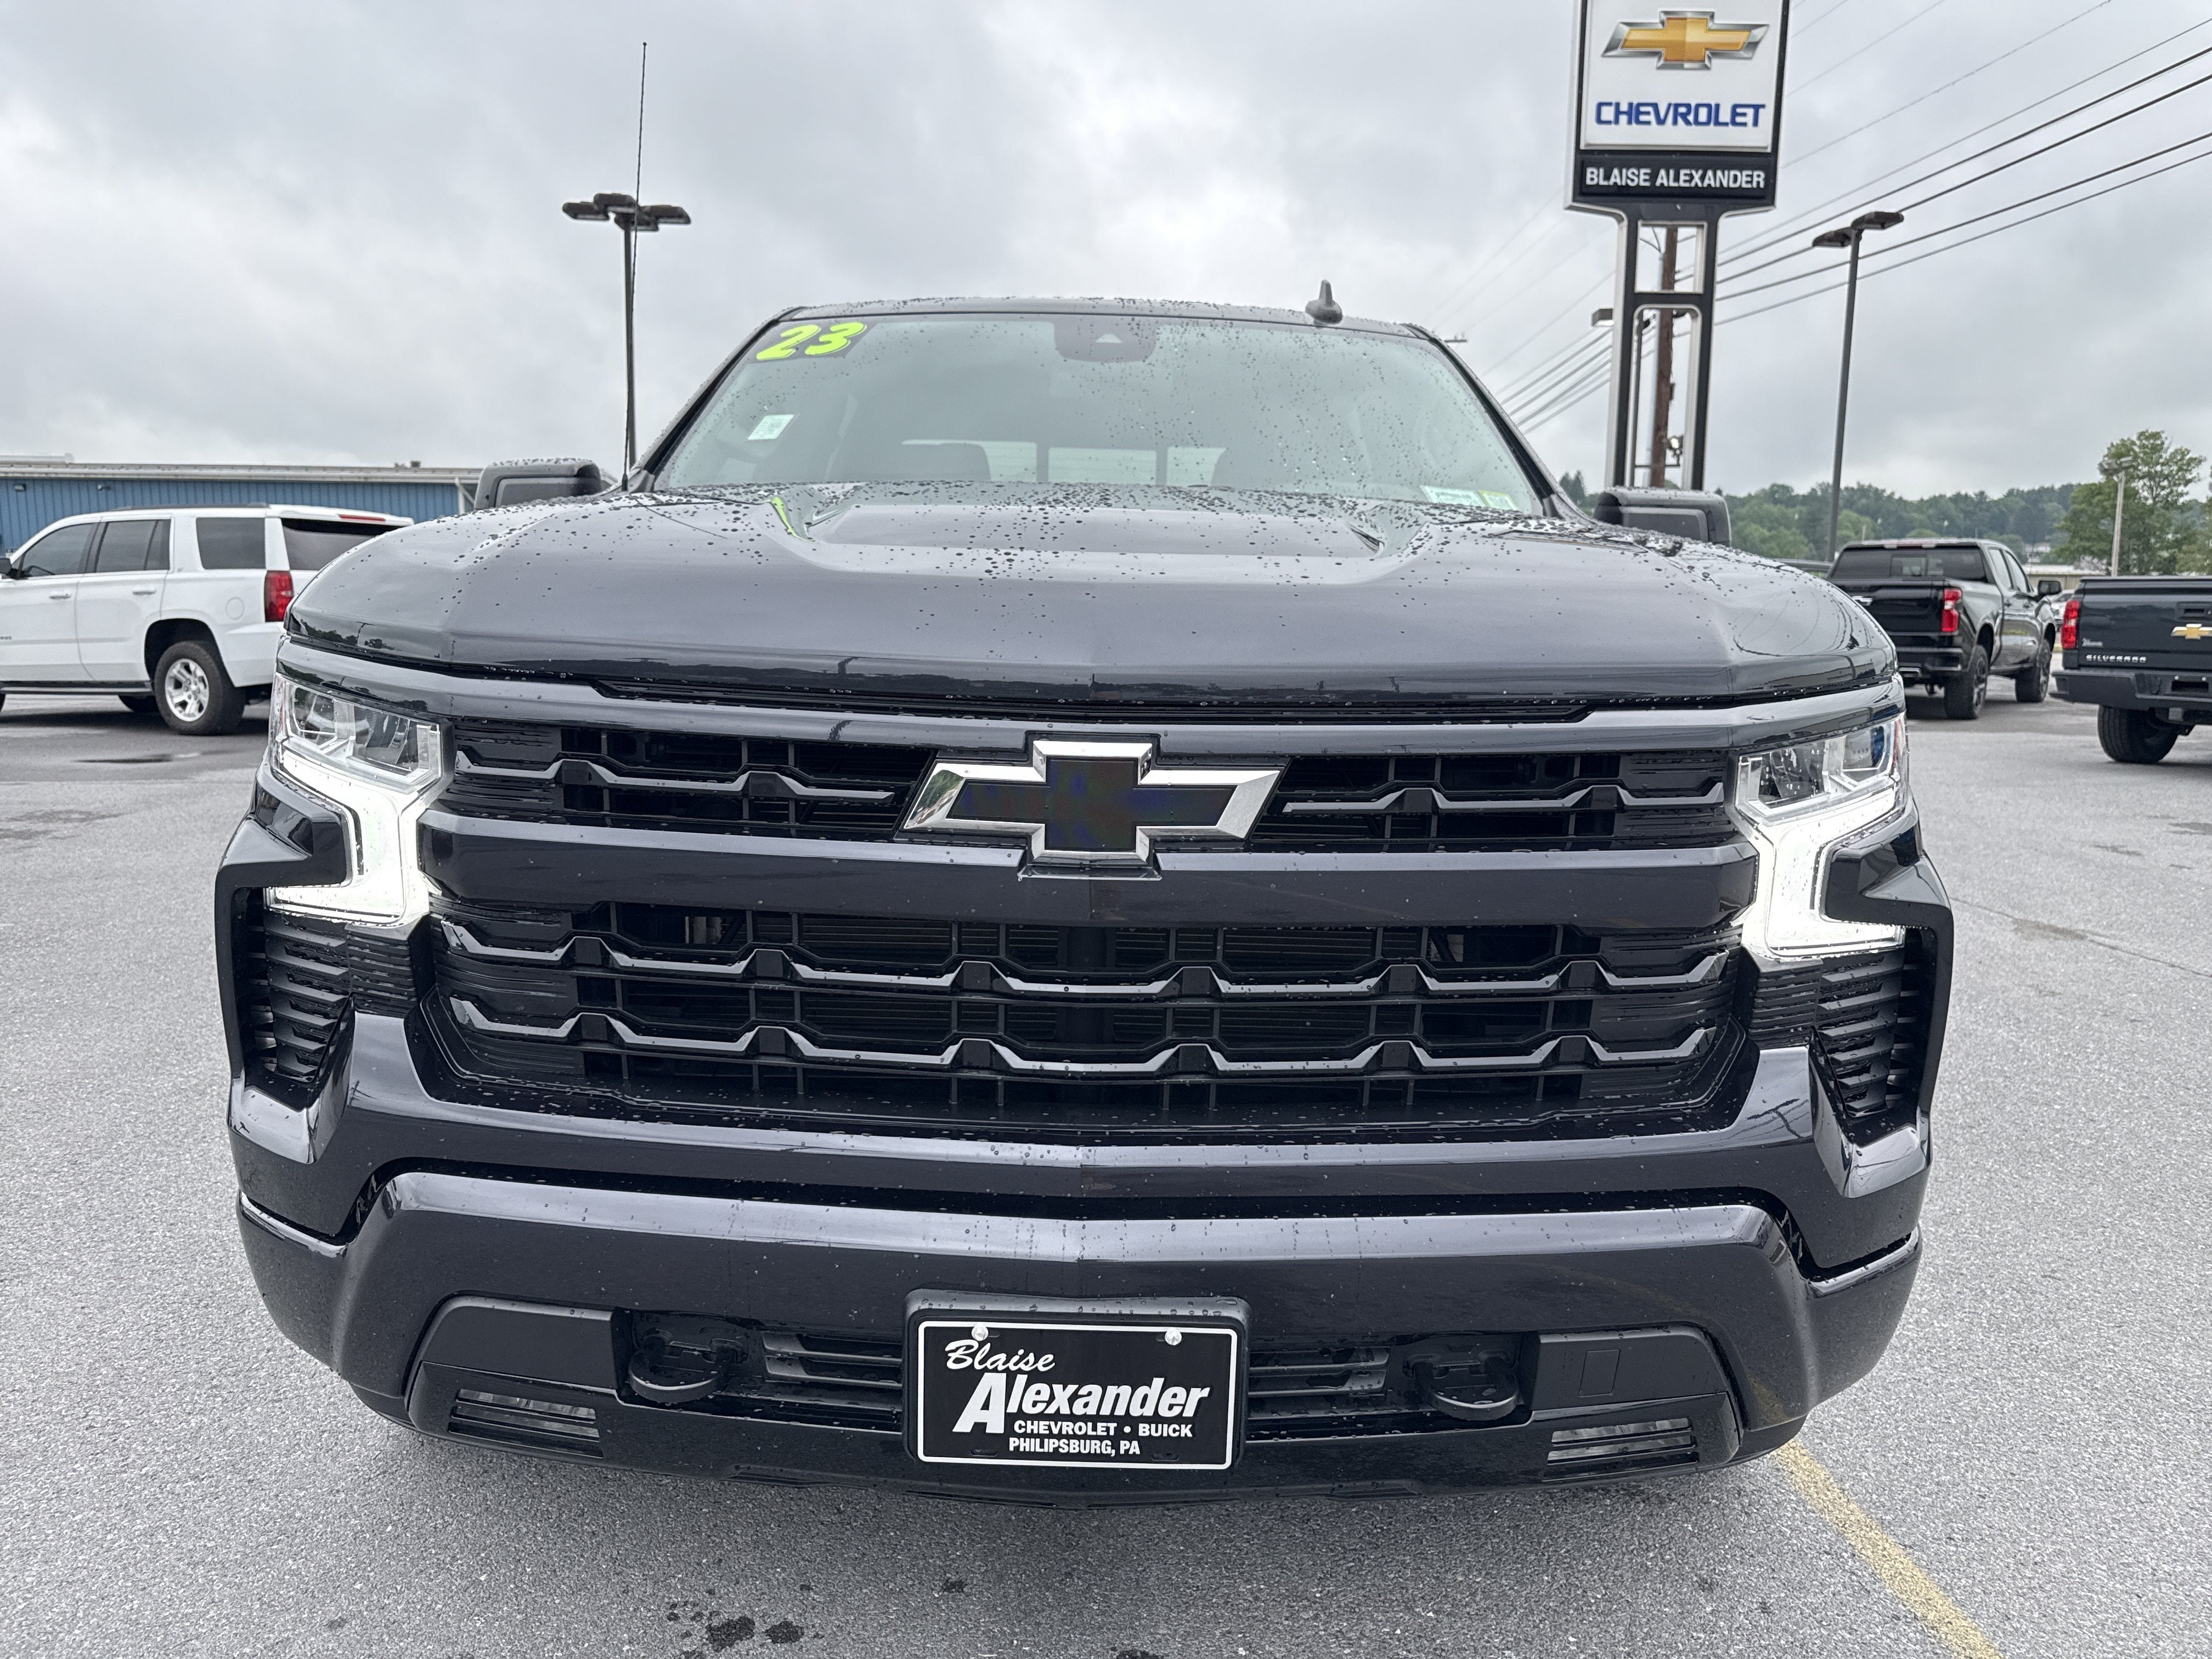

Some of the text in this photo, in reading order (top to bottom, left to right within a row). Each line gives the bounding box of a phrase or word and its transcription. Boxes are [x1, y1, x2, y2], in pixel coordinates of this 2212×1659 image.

[1595, 101, 1765, 127] CHEVROLET
[1585, 167, 1765, 188] BLAISE ALEXANDER
[756, 321, 867, 360] 23
[945, 1339, 1055, 1372] Blaise
[952, 1372, 1210, 1434] Alexander
[1013, 1420, 1193, 1437] CHEVROLET BUICK
[1008, 1436, 1141, 1457] PHILIPSBURG, PA
